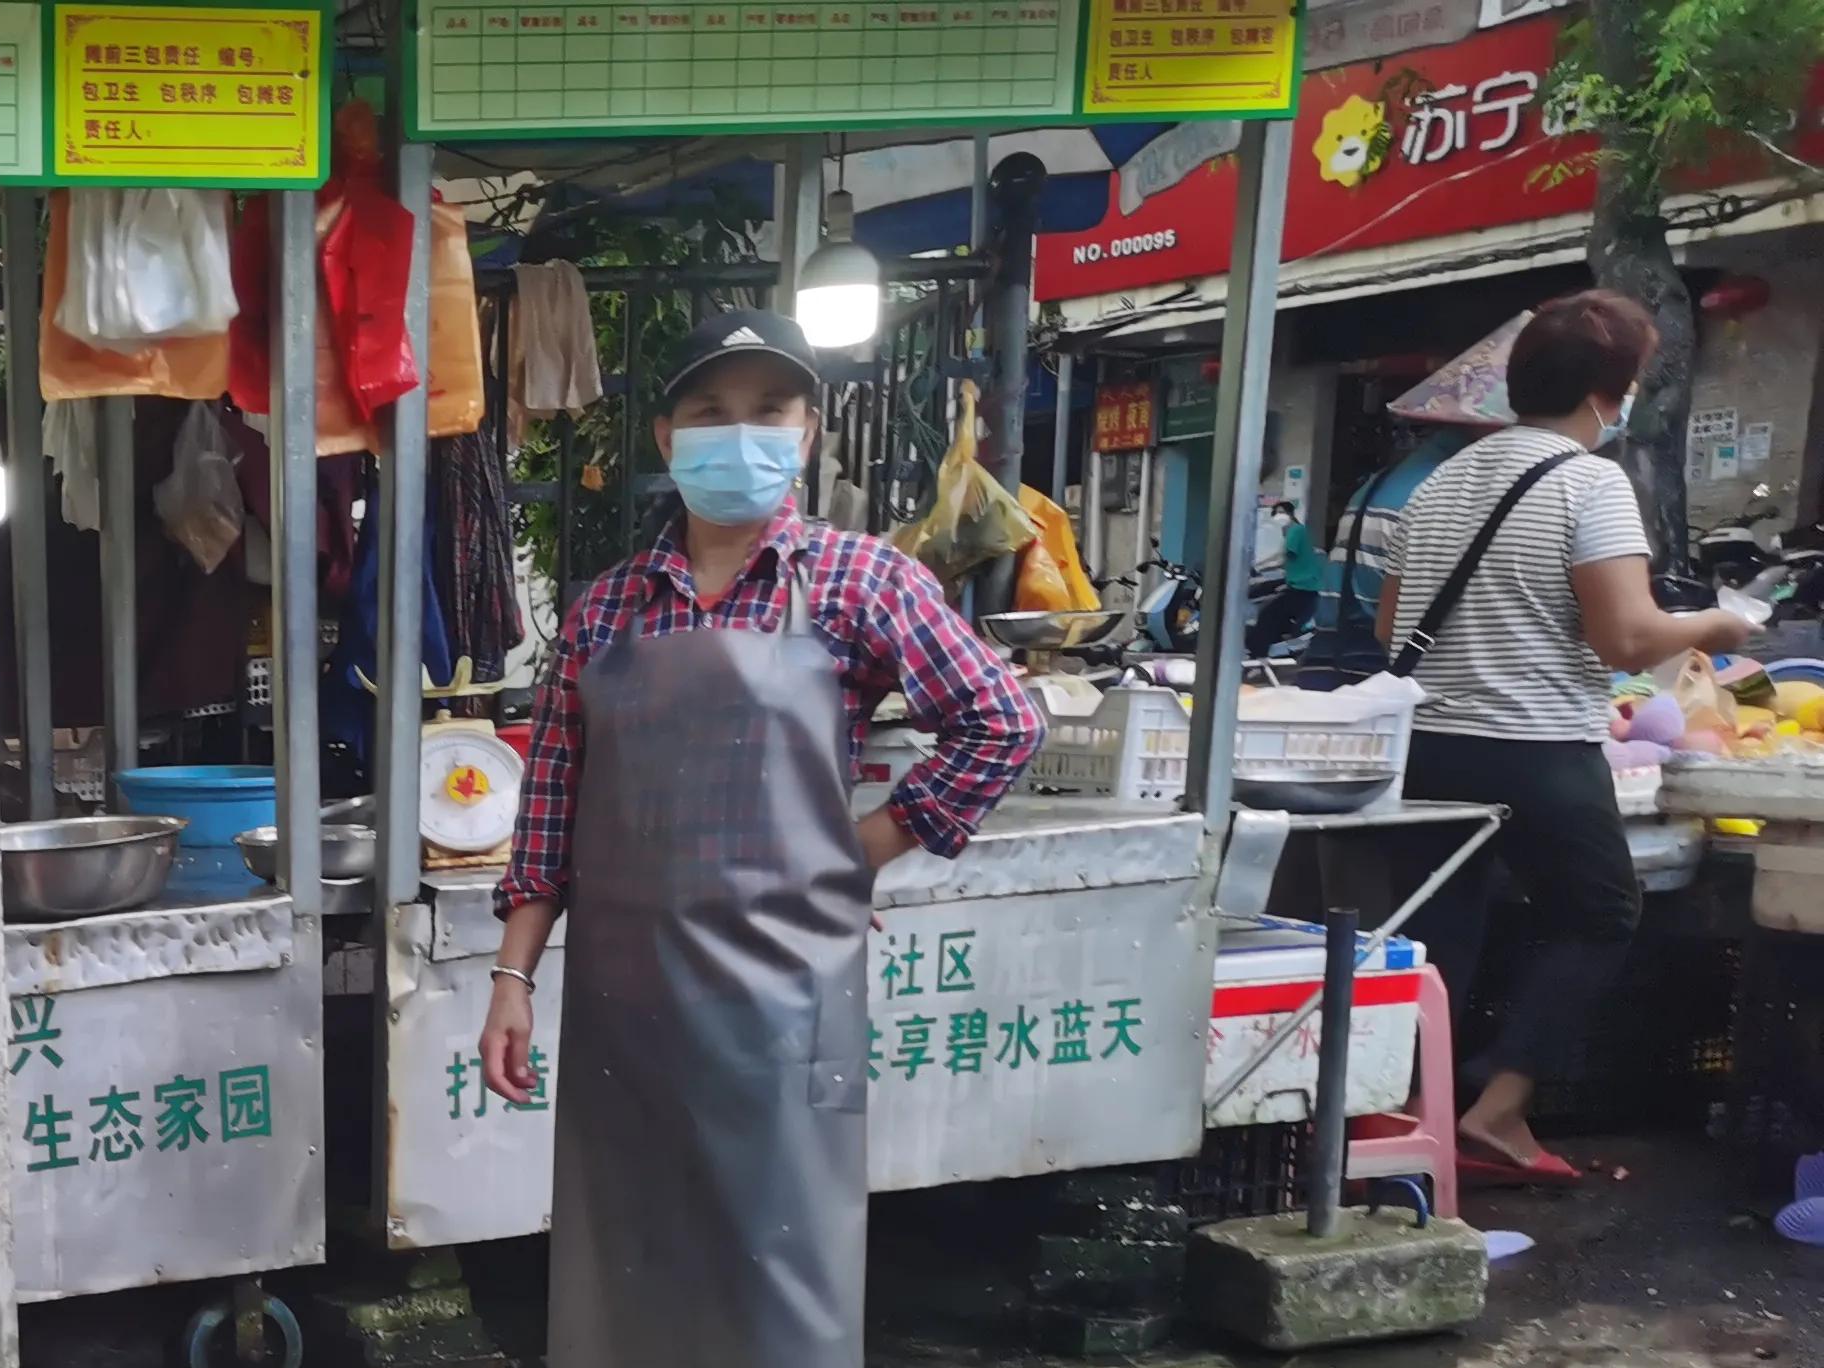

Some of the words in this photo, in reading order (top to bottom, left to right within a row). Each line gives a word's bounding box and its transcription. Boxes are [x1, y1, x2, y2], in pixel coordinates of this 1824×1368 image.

[82, 81, 140, 102] 包卫生
[1072, 229, 1176, 265] NO.000095
[879, 930, 976, 1000] 社区
[23, 1064, 272, 1172] 生态家园
